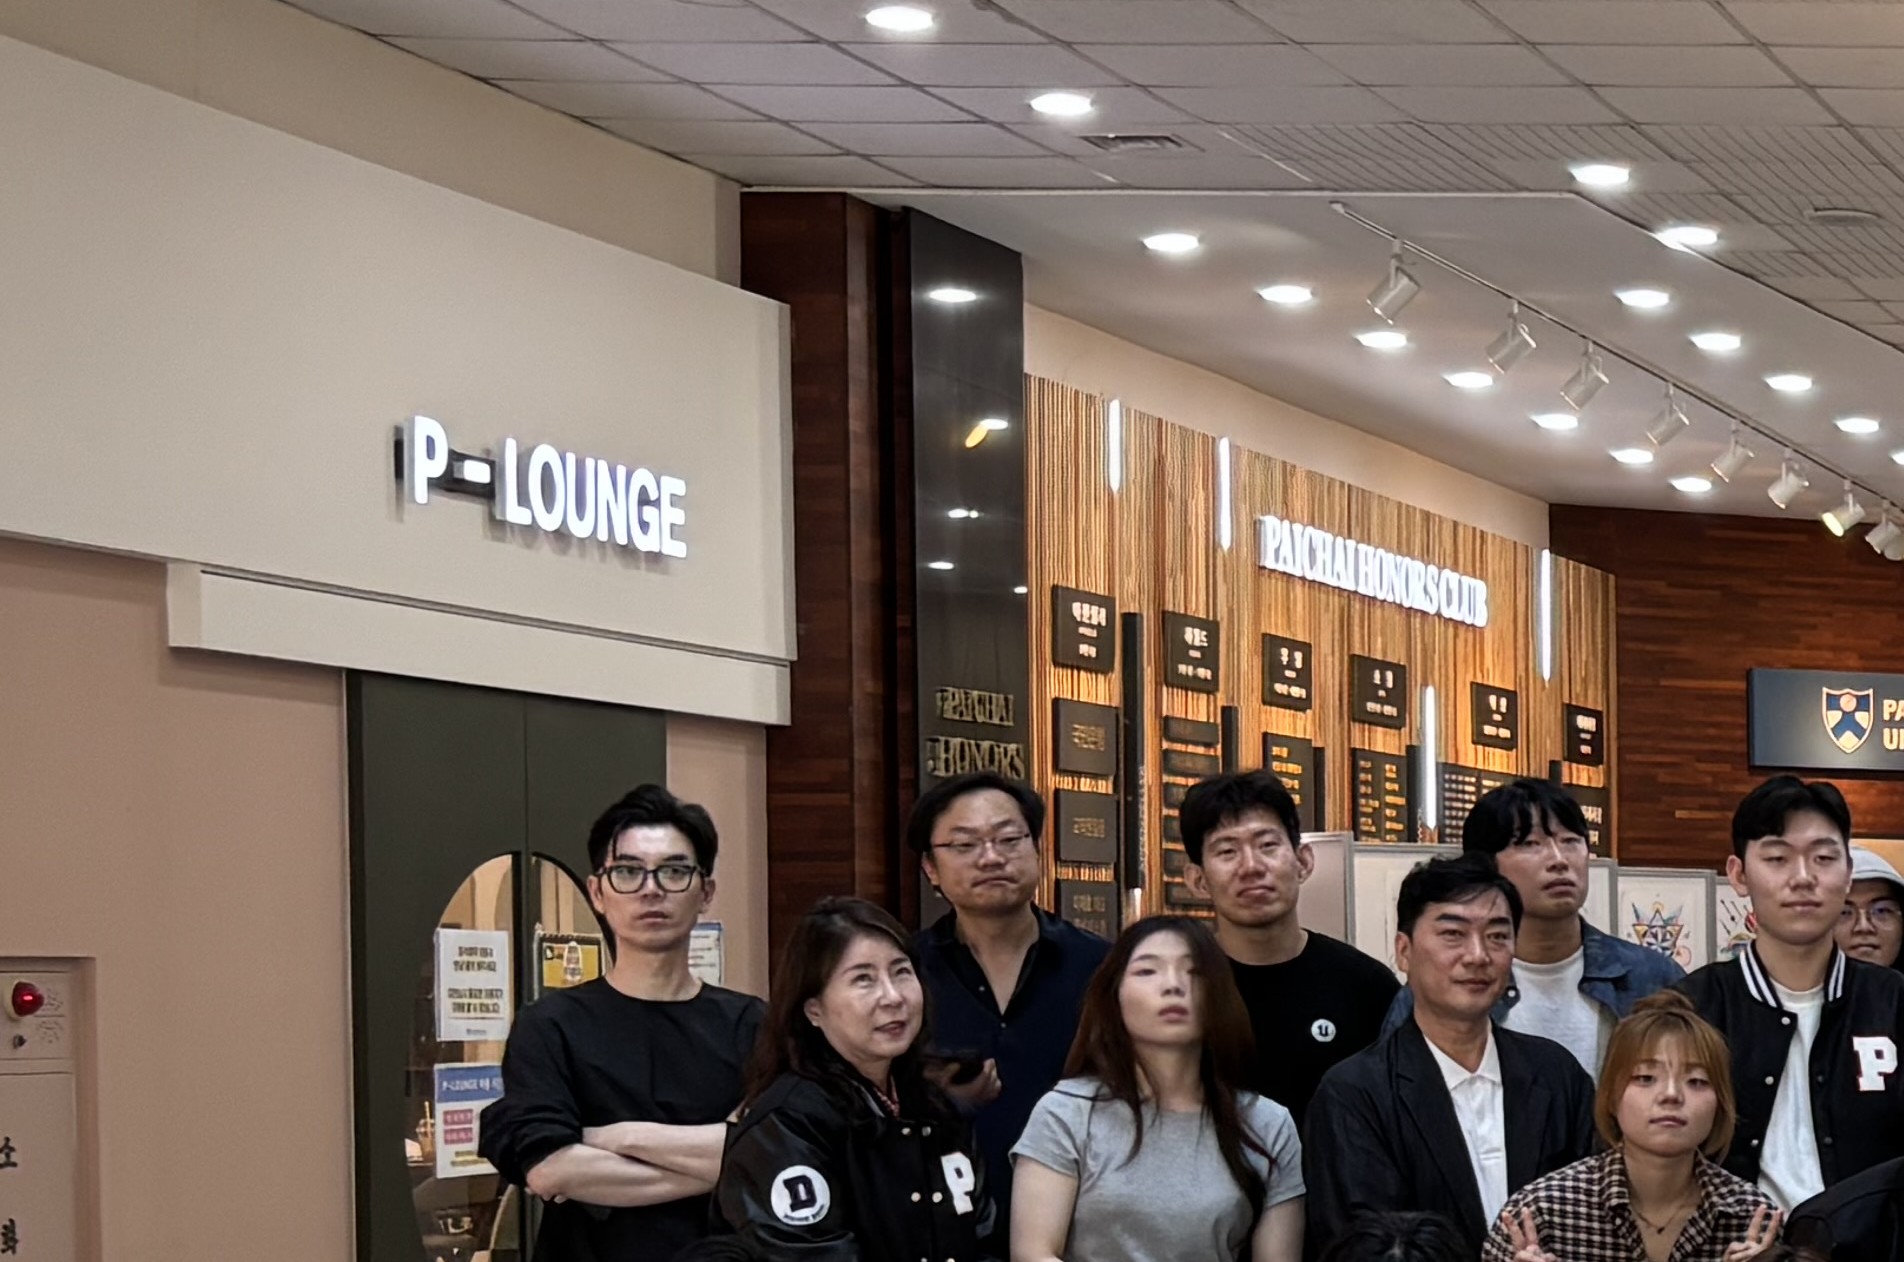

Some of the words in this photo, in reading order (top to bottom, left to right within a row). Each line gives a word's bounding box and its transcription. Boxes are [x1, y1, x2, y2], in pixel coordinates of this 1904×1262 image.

[1357, 543, 1439, 616] HONORS
[1439, 568, 1489, 629] CLUB
[1853, 1036, 1898, 1091] P
[783, 1174, 818, 1213] D
[941, 1151, 976, 1216] P
